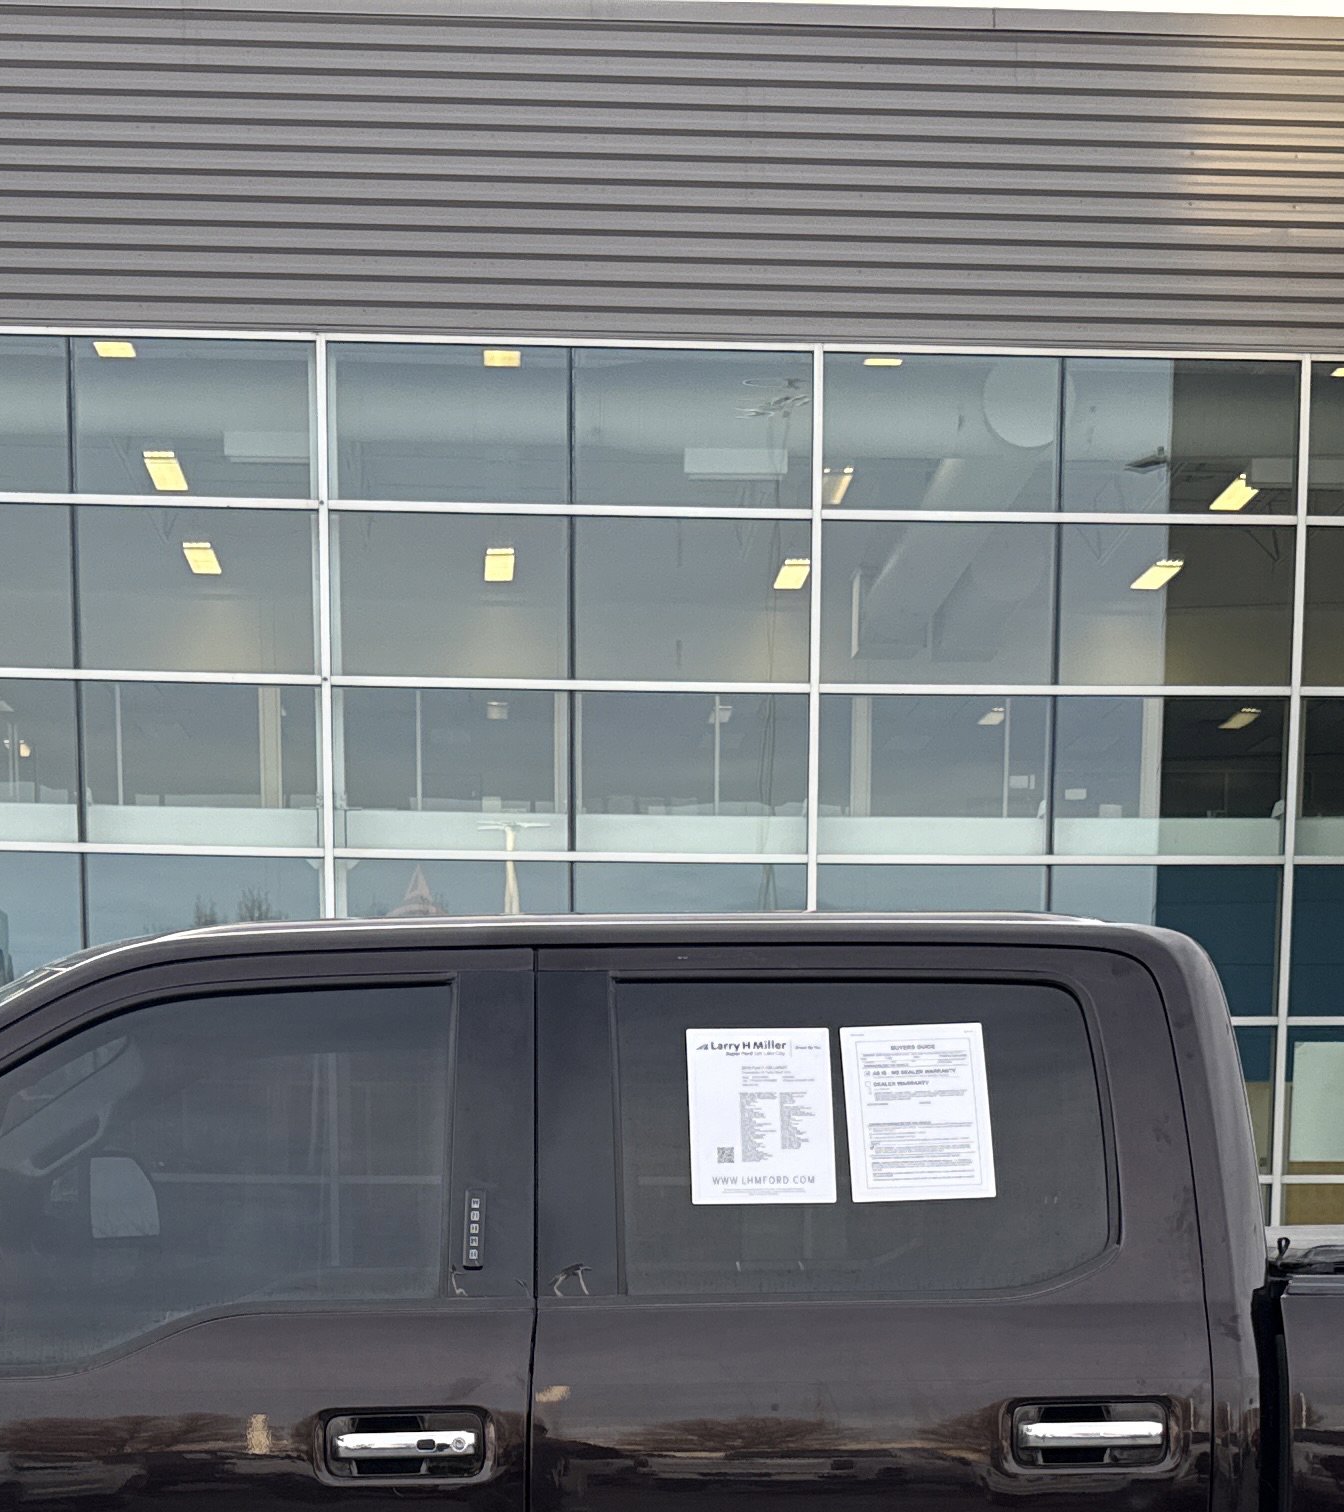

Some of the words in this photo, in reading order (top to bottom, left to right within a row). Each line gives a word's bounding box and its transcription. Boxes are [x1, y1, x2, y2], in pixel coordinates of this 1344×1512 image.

[710, 1041, 740, 1052] Larry
[742, 1041, 751, 1050] H
[752, 1039, 787, 1050] Miller
